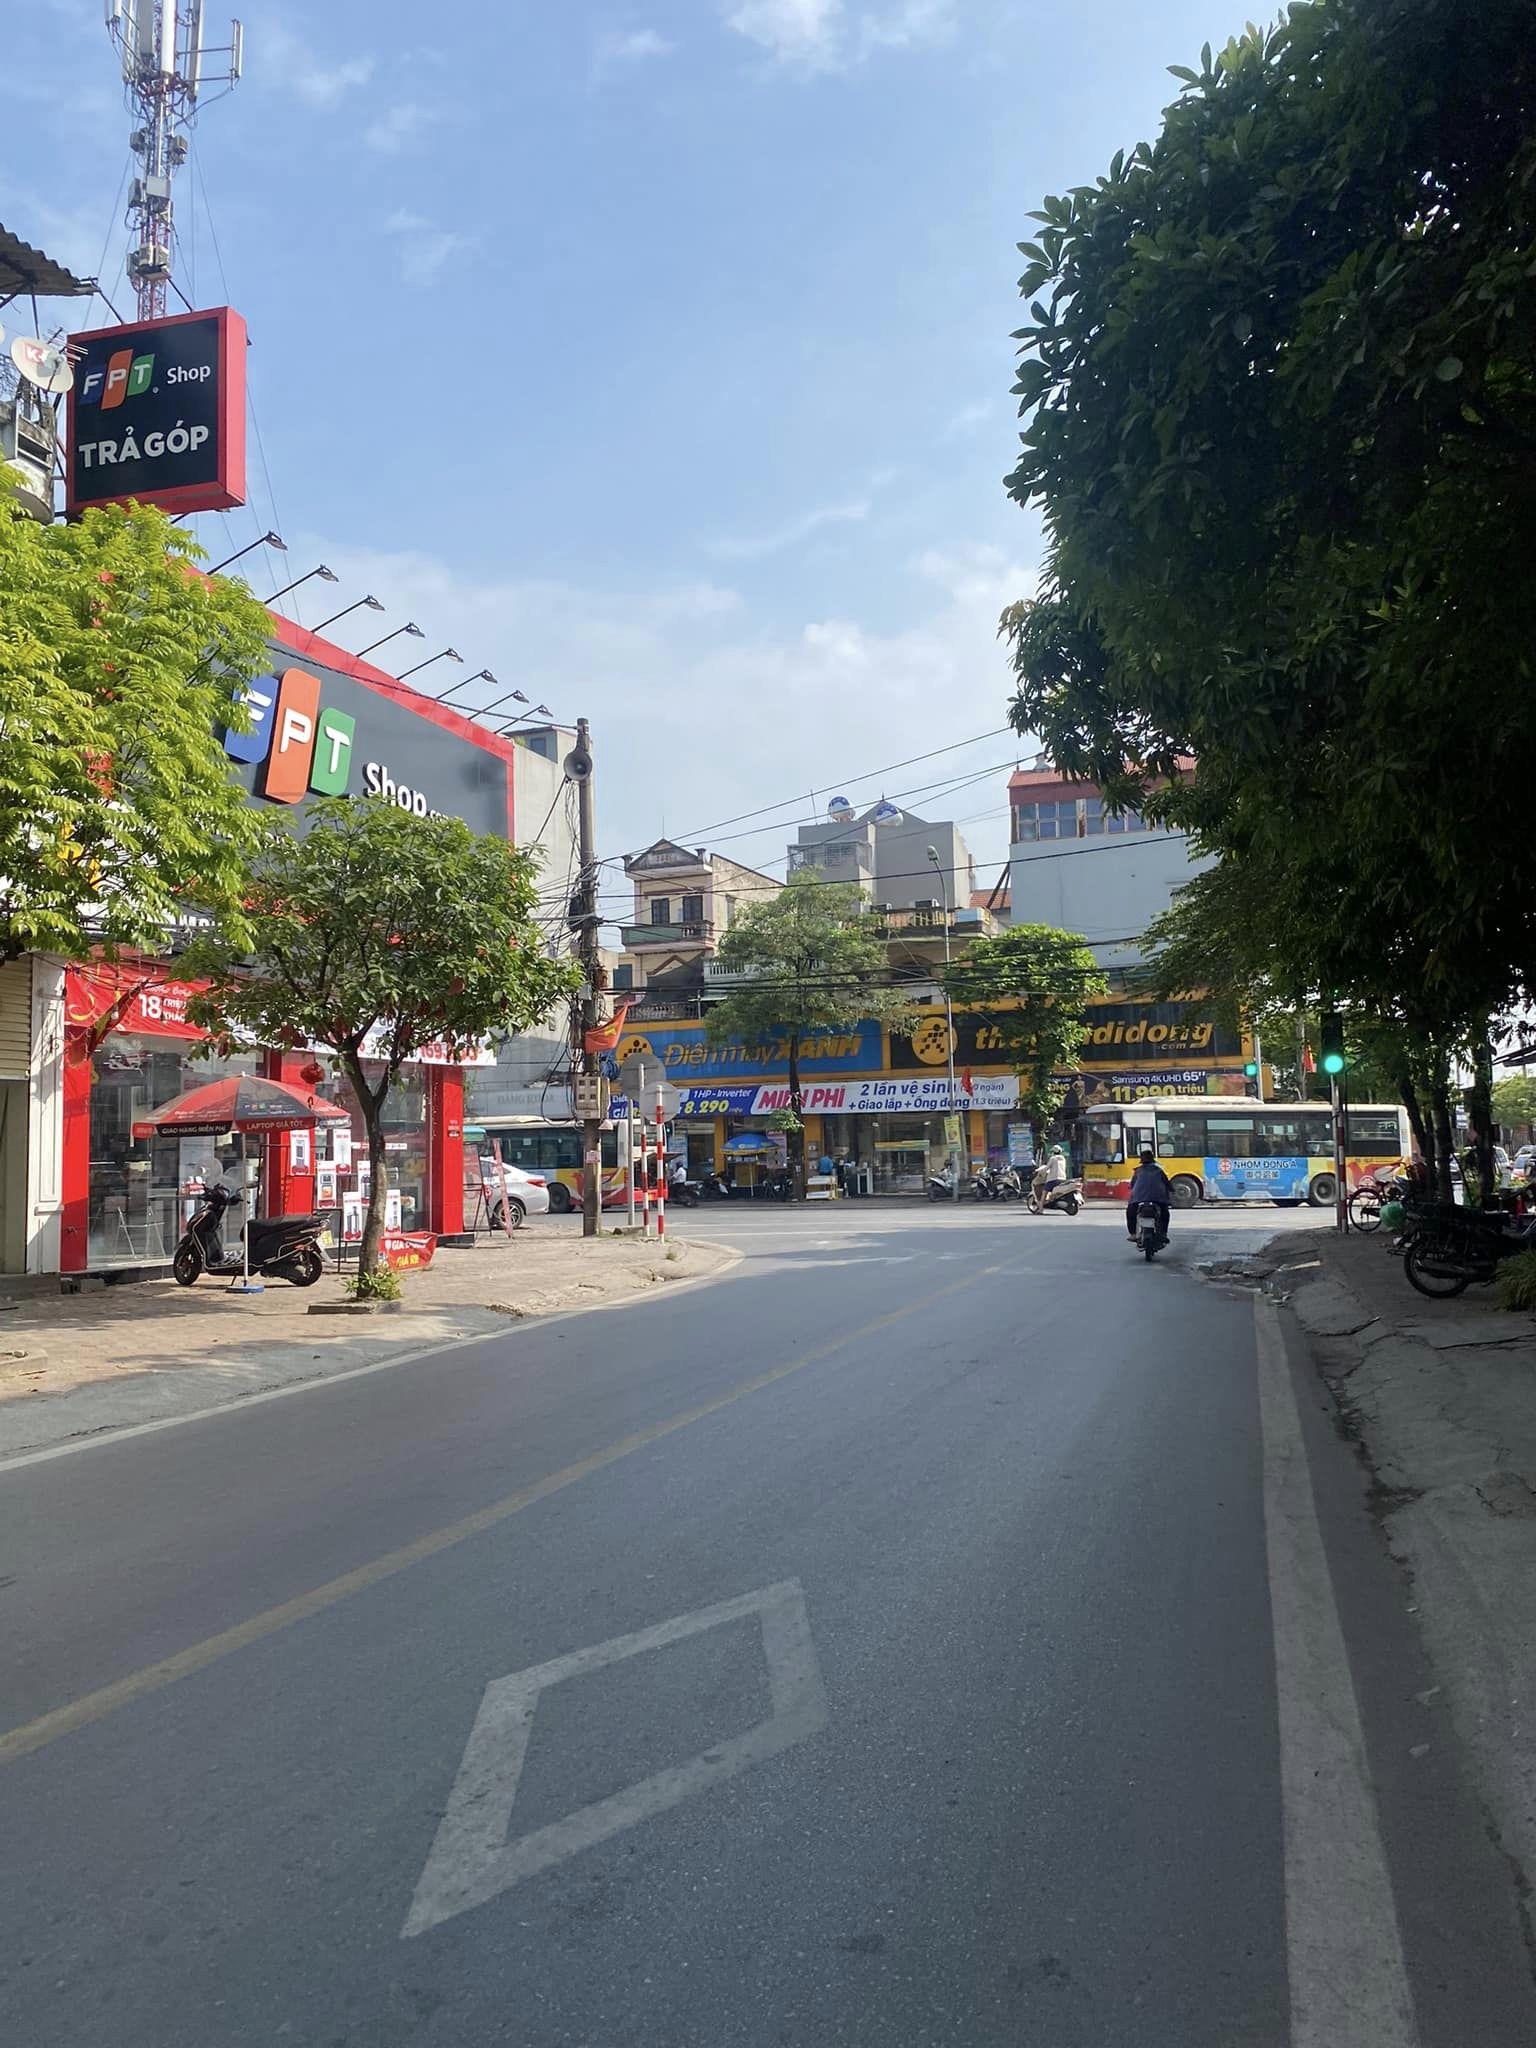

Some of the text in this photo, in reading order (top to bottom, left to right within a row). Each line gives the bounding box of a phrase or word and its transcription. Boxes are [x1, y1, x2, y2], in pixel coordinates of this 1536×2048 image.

[83, 364, 211, 396] FPT Shop
[79, 420, 208, 468] TRẢ GÓP
[365, 762, 427, 817] Shop
[138, 994, 162, 1019] 18
[1112, 1075, 1150, 1084] Samsung
[1163, 1074, 1182, 1082] UHD
[717, 1089, 752, 1097] Inverter
[861, 1084, 869, 1096] 2
[901, 1081, 918, 1098] vệ
[1178, 1083, 1205, 1095] triệu
[684, 1100, 729, 1114] 8.290
[858, 1099, 882, 1110] Giao
[246, 1122, 275, 1130] LAPTOP
